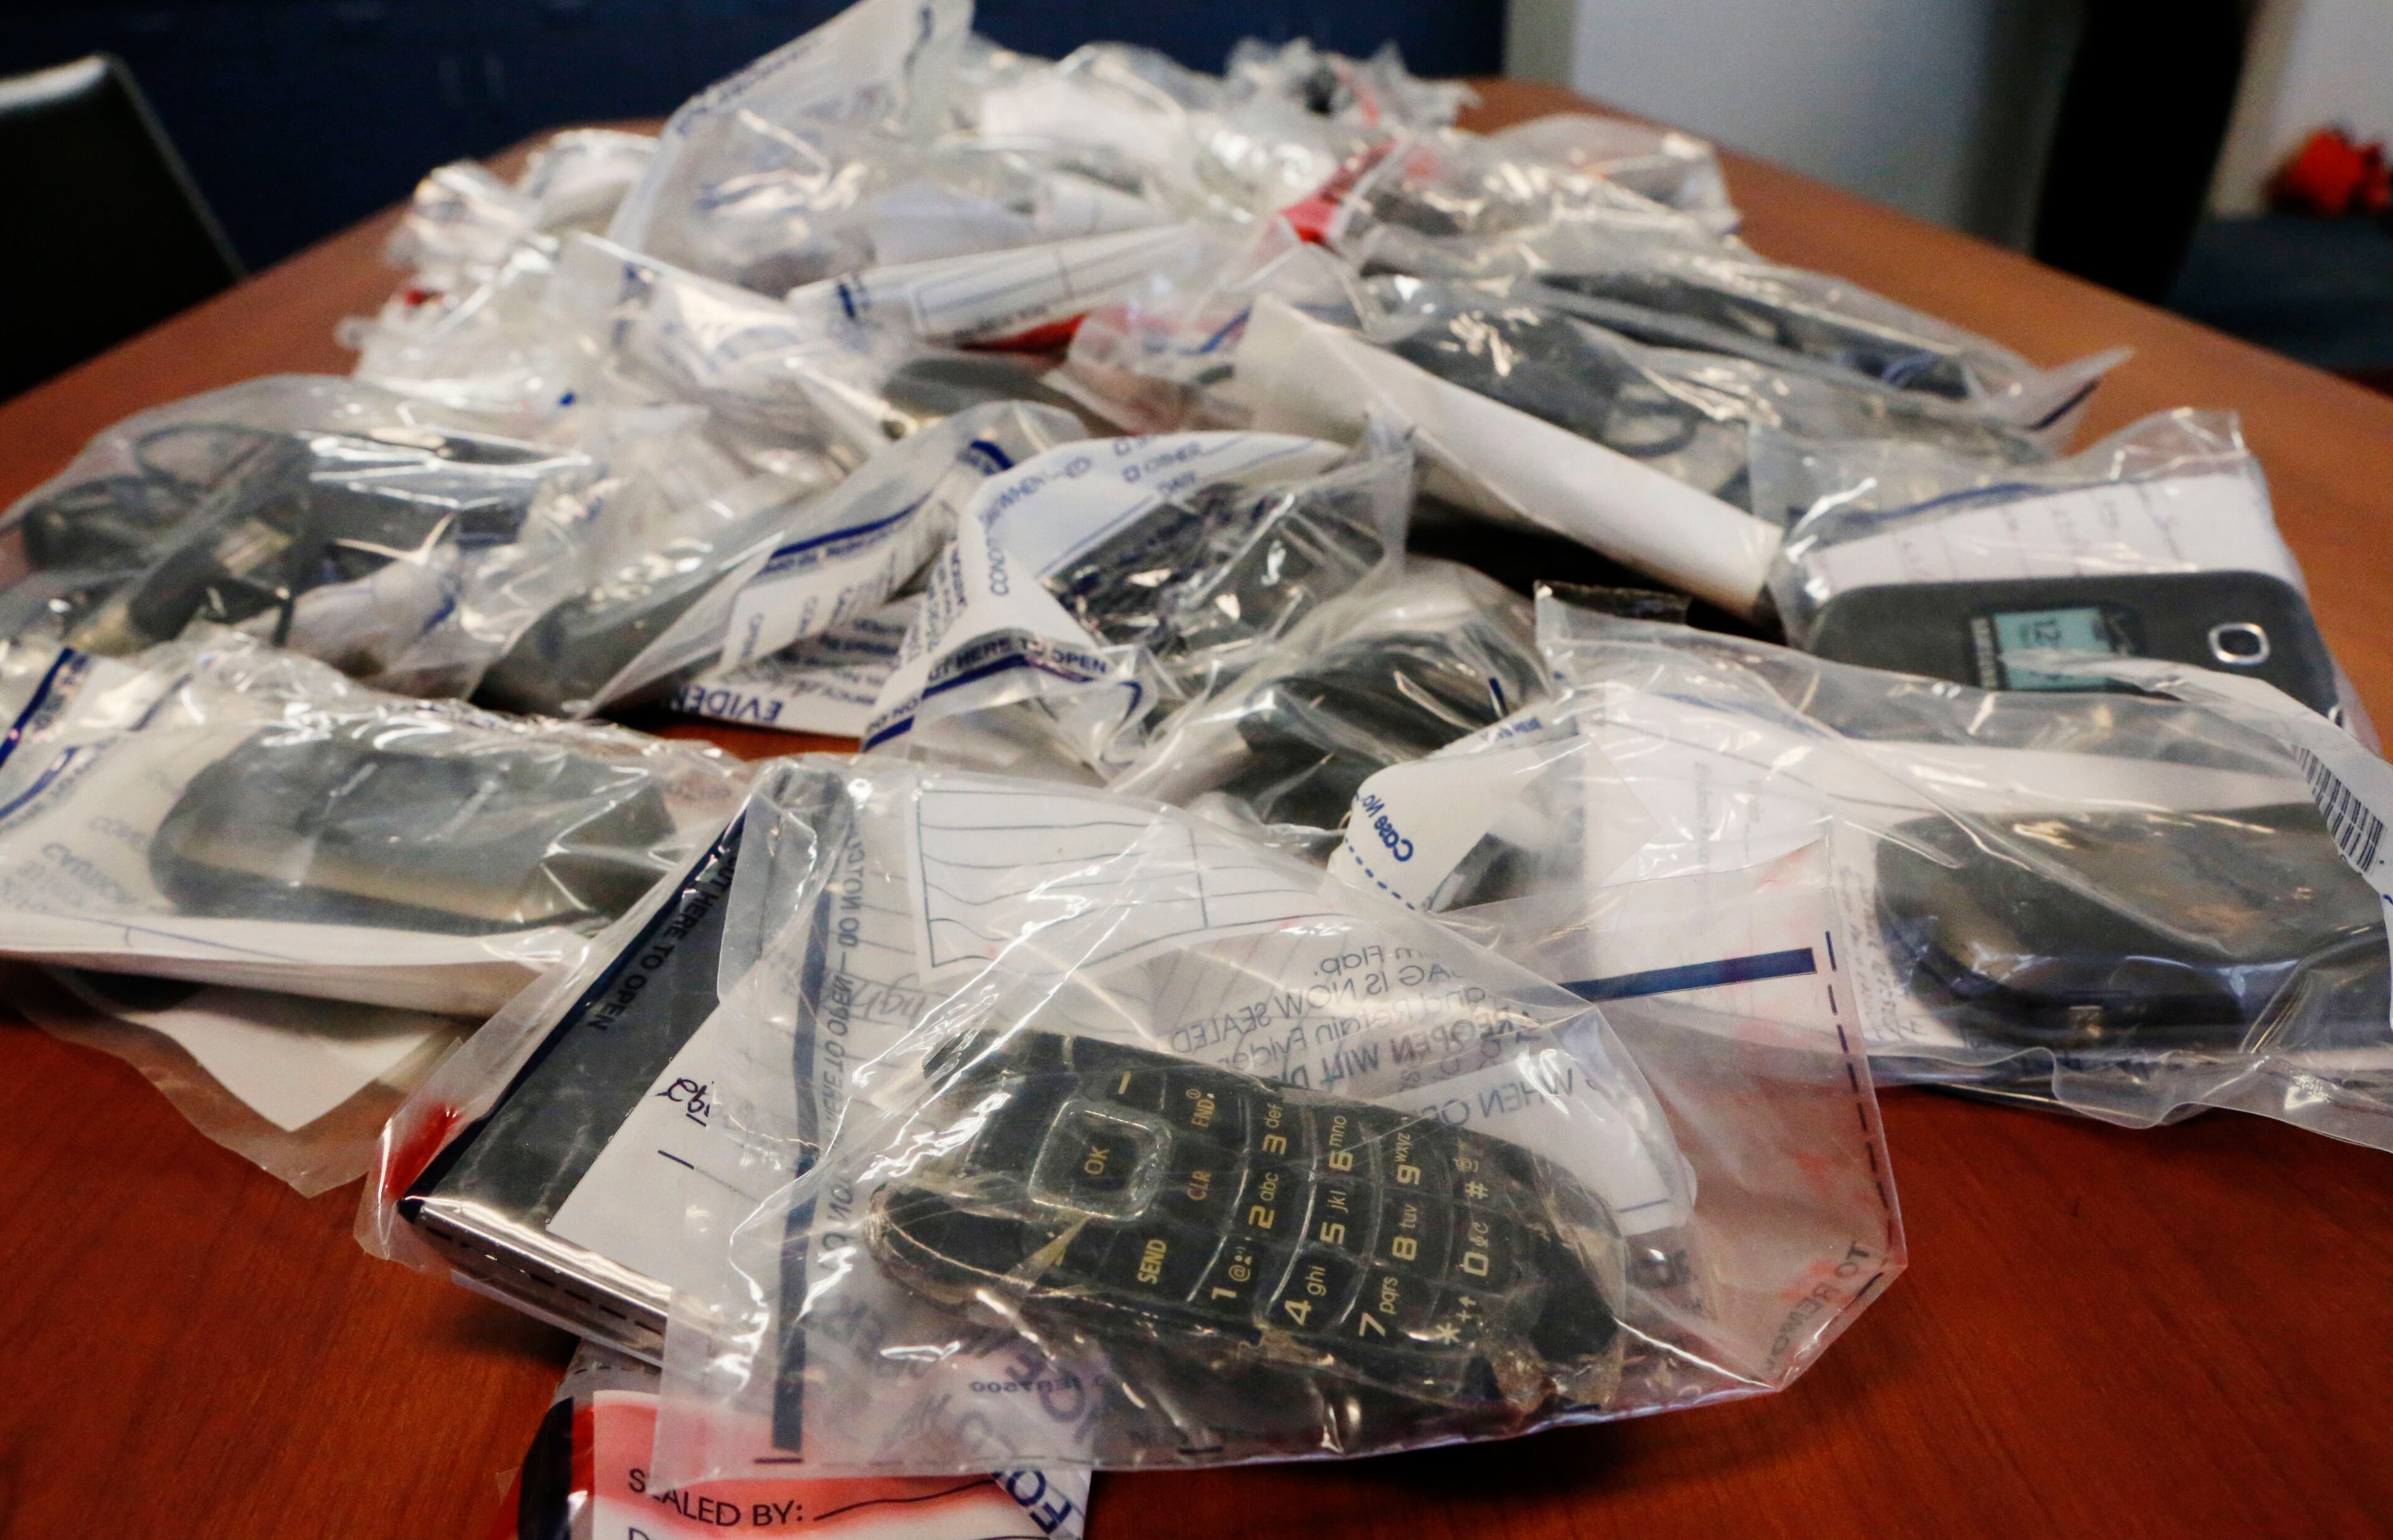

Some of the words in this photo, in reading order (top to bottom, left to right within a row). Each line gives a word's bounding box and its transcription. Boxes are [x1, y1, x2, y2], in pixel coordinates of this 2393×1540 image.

[641, 944, 676, 970] TO
[588, 973, 647, 1031] OPEN
[1191, 1099, 1216, 1129] END
[1263, 1102, 1283, 1129] def
[1263, 1134, 1287, 1155] 3
[1328, 1115, 1347, 1148] mno
[1084, 1147, 1111, 1175] OK
[1328, 1150, 1354, 1172] 6
[1394, 1132, 1411, 1163] wxyz
[1186, 1170, 1212, 1201] CLR
[1259, 1172, 1279, 1202] abc
[1396, 1164, 1421, 1185] 9
[1327, 1189, 1349, 1213] jkl
[1248, 1205, 1275, 1230] 2
[1399, 1204, 1418, 1230] tuv
[1319, 1221, 1346, 1245] 5
[1137, 1238, 1167, 1284] SEND
[1392, 1236, 1418, 1261] 8
[1462, 1250, 1489, 1276] 0
[1211, 1286, 1237, 1299] 1
[1284, 1299, 1312, 1326] 4
[1305, 1265, 1327, 1296] ghi
[1358, 1312, 1386, 1337] 7
[1378, 1276, 1400, 1315] pqrs
[627, 1468, 742, 1527] SALED
[752, 1499, 805, 1527] BY:
[992, 1470, 1072, 1534] FO
